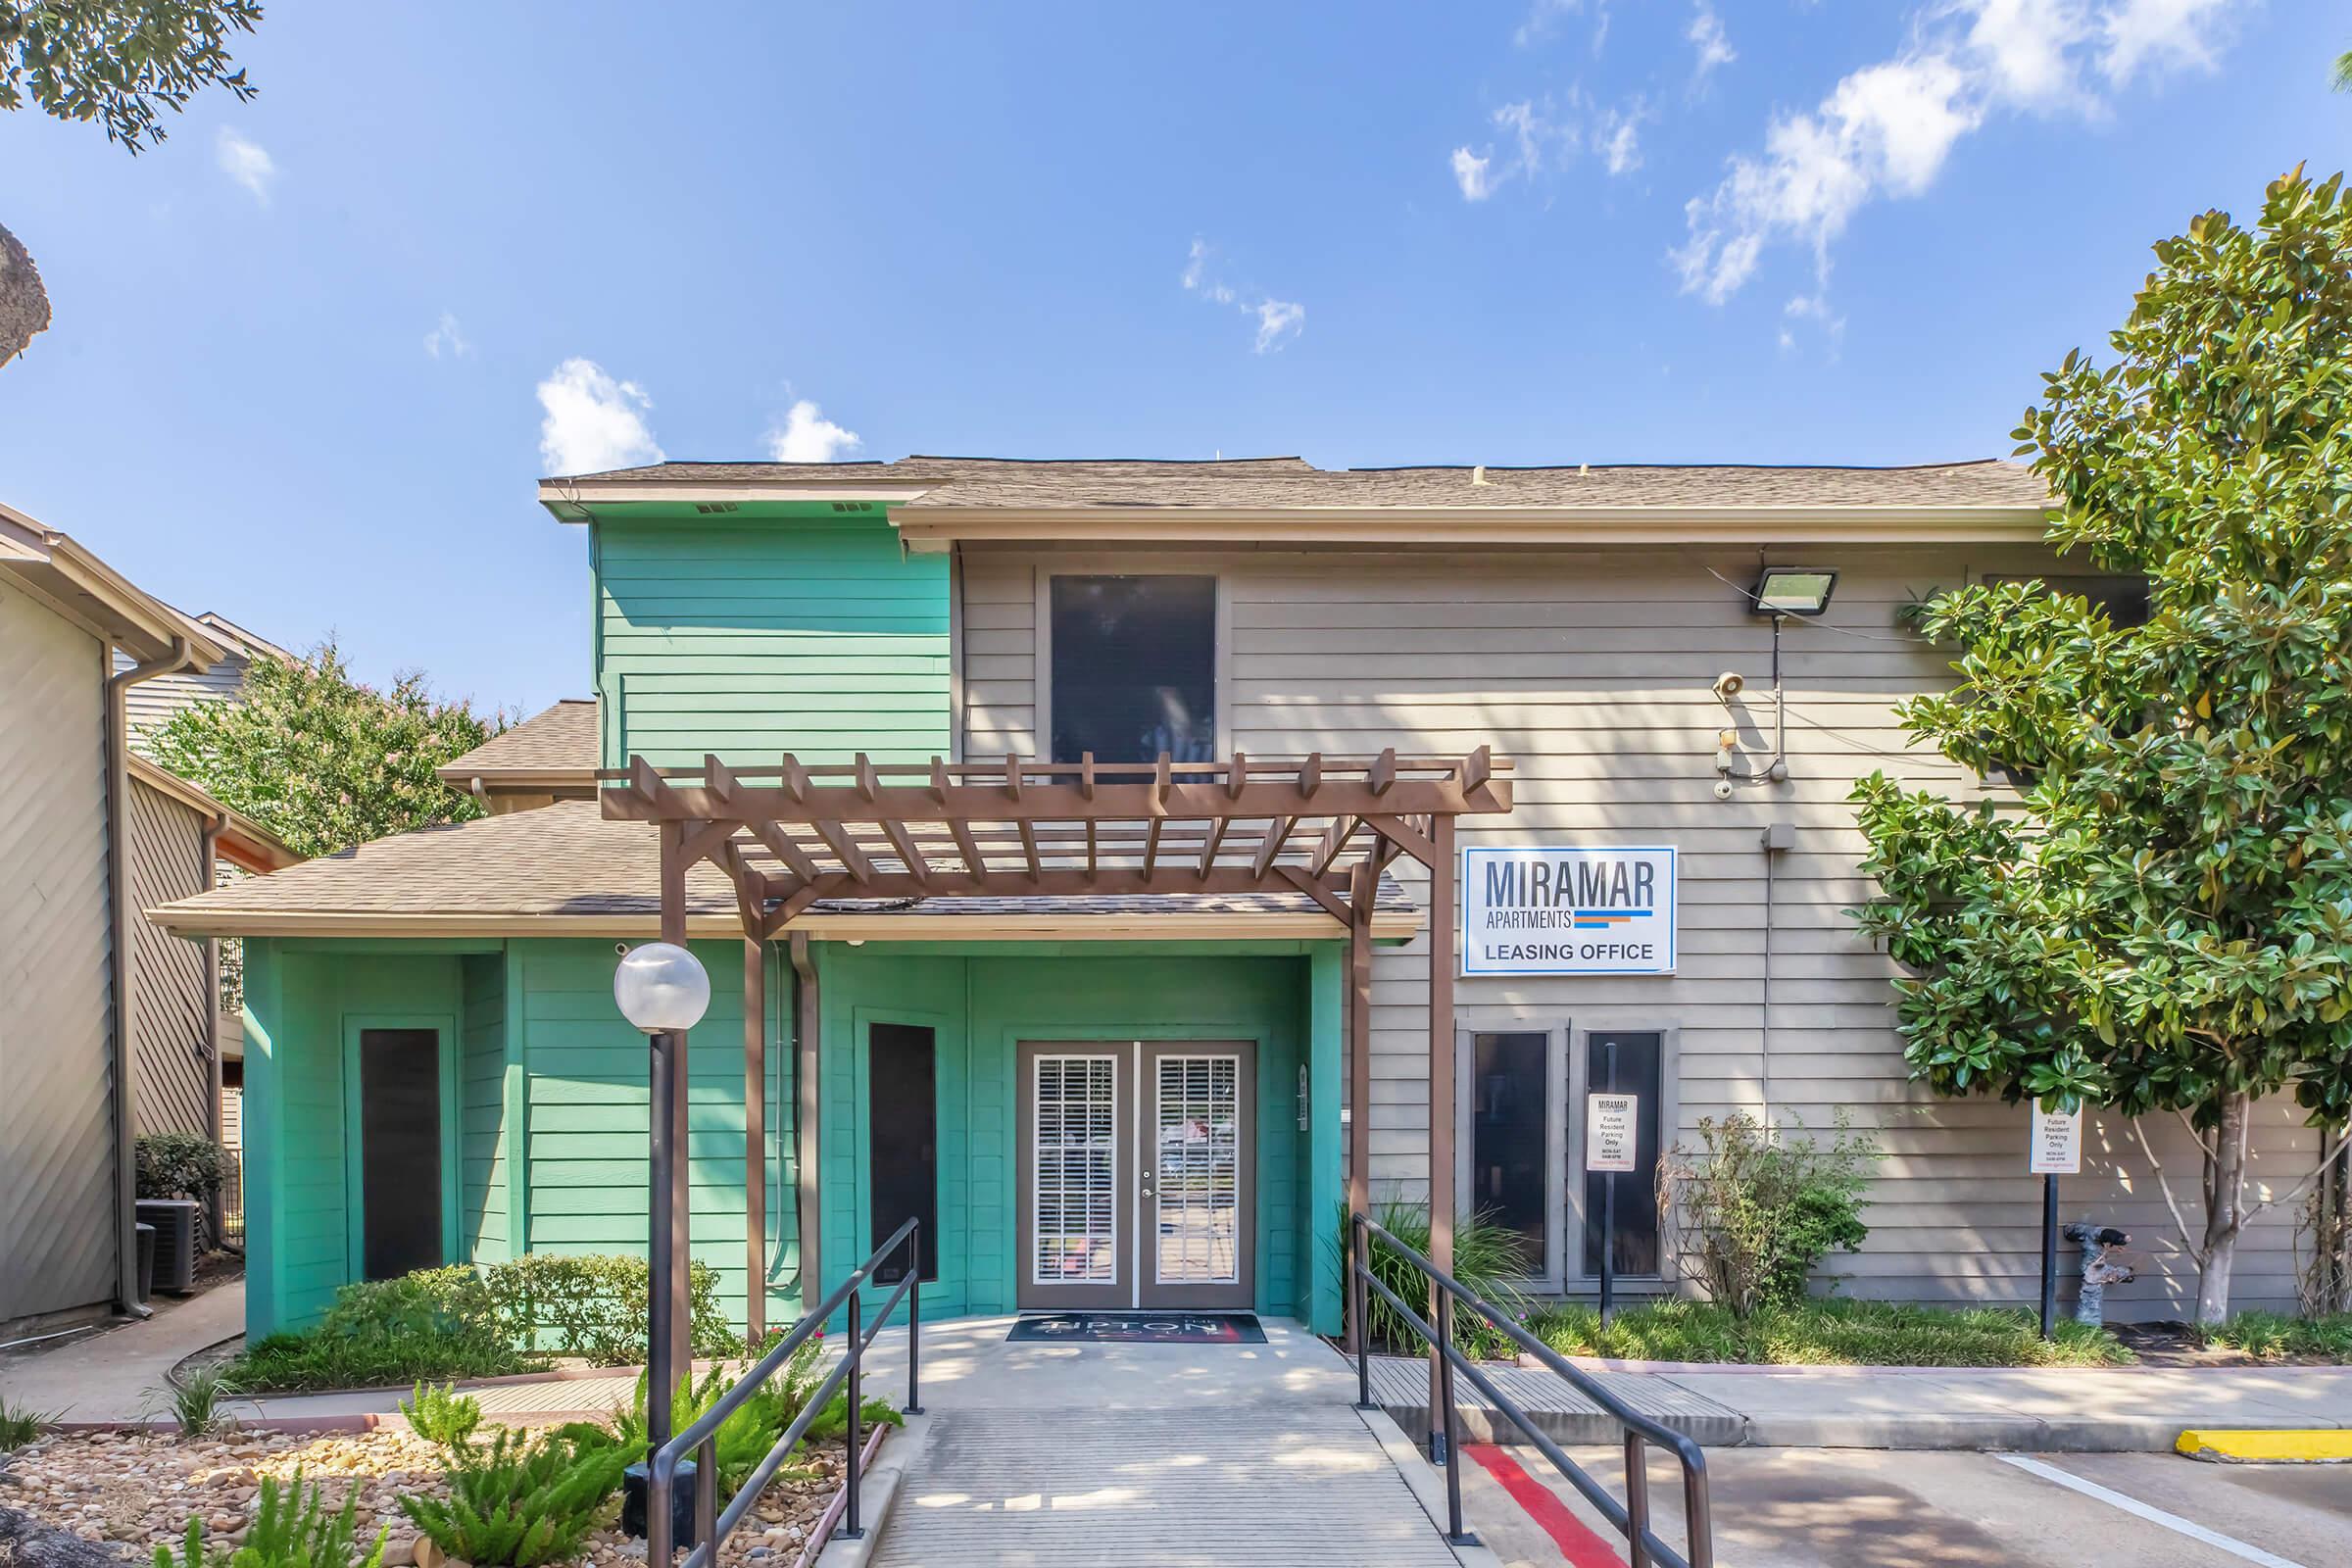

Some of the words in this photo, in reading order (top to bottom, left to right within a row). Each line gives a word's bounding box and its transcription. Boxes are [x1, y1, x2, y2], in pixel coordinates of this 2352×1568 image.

[1486, 861, 1654, 907] MIRAMAR
[1486, 909, 1572, 929] APARTMENTS
[1485, 944, 1574, 960] LEASING
[1581, 943, 1654, 960] OFFICE
[1598, 1101, 1628, 1109] MIRAMAR
[1042, 1322, 1218, 1331] TIPTON
